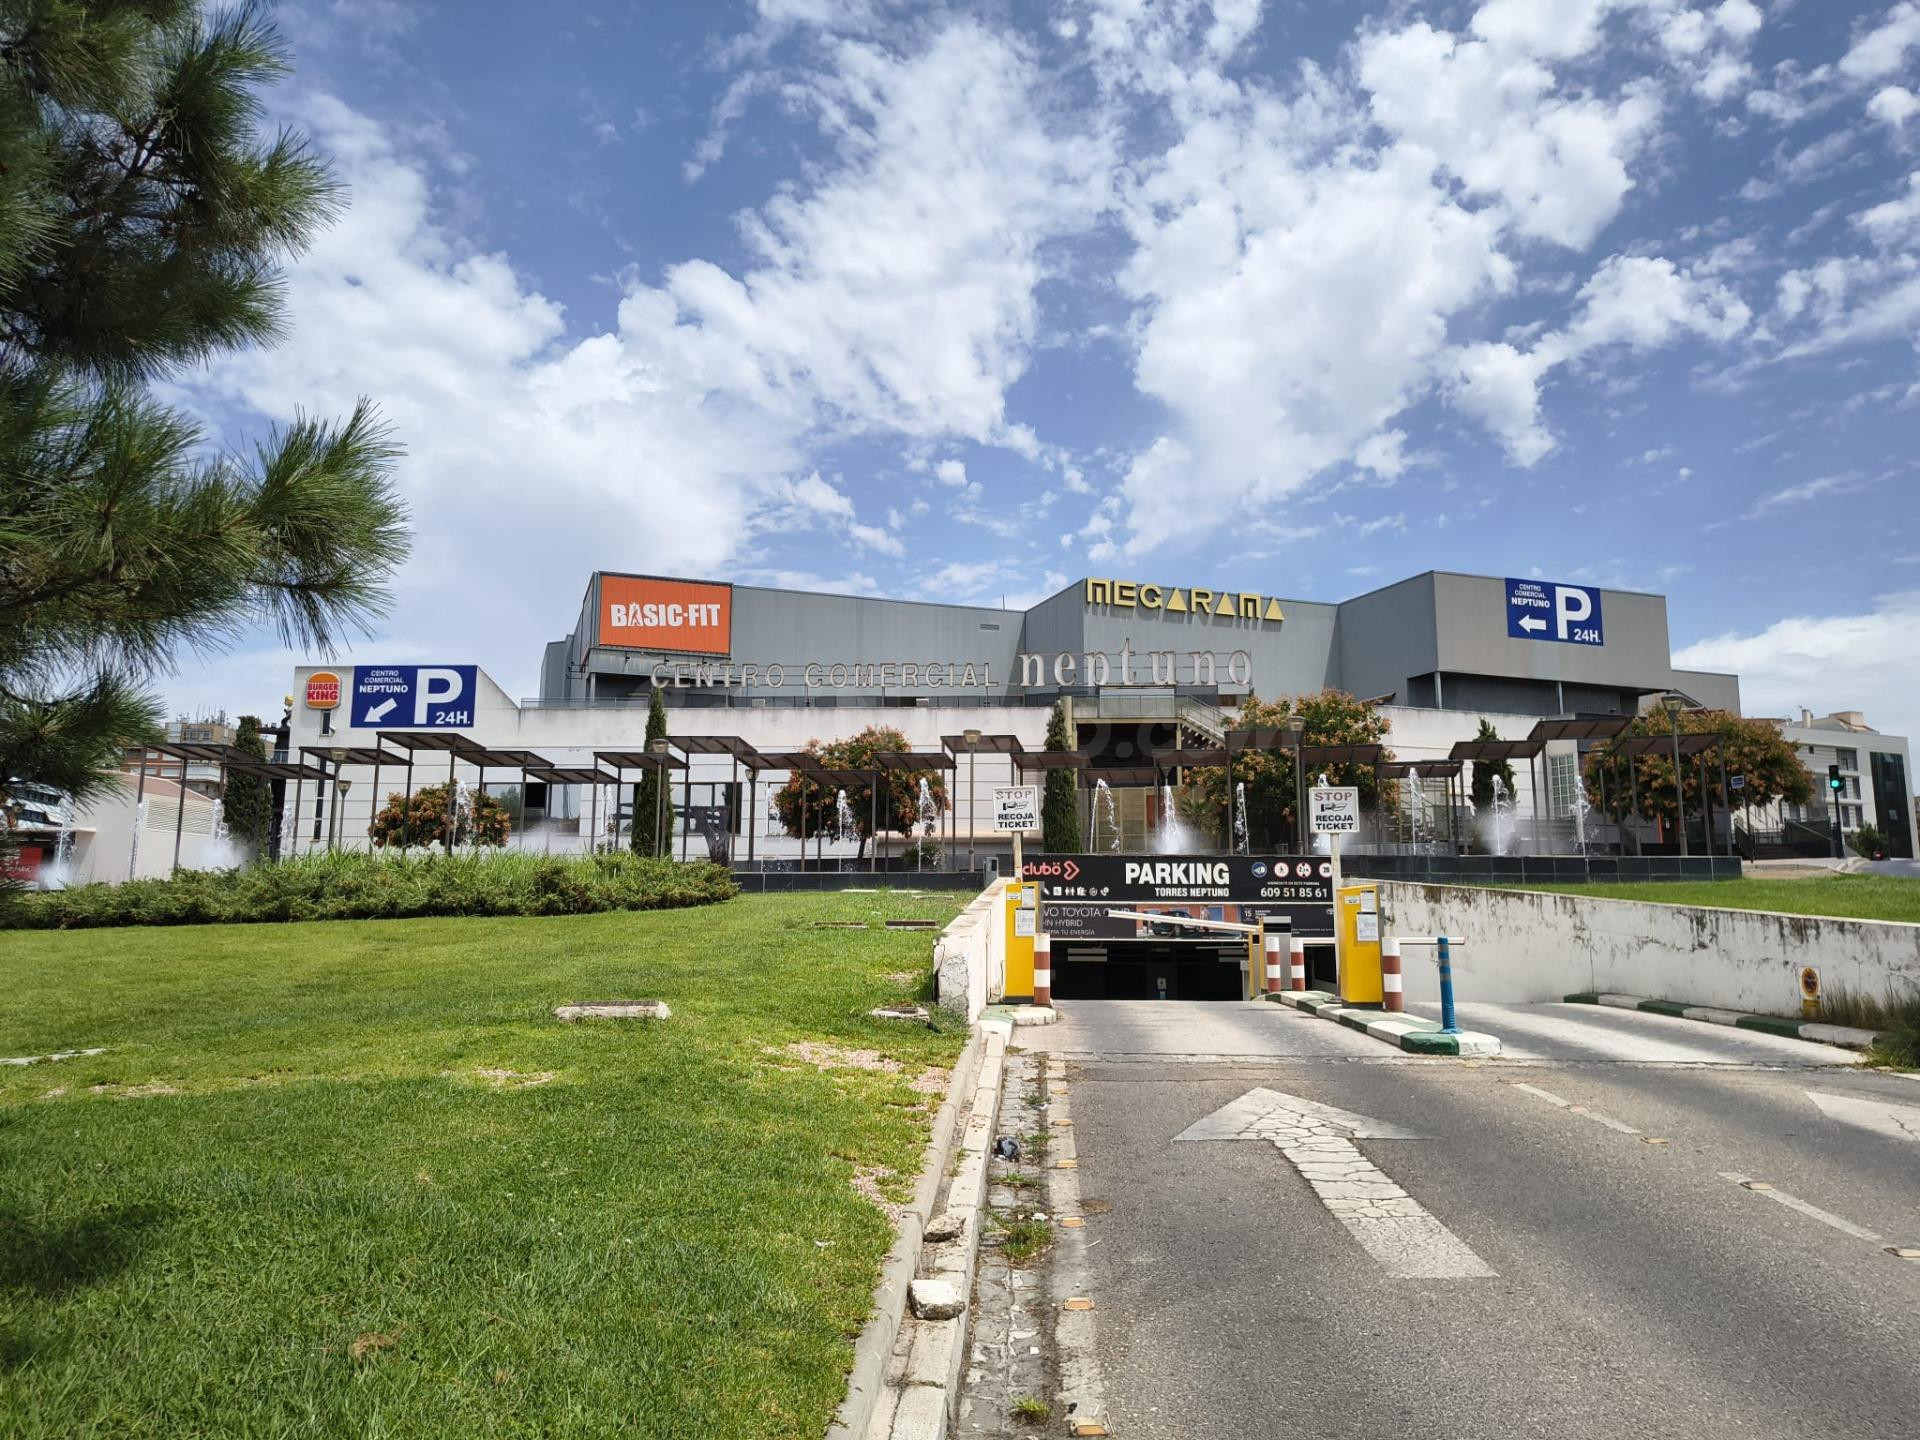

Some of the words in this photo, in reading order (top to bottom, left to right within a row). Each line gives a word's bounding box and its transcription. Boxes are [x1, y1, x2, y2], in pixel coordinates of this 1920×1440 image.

[1519, 584, 1541, 592] CENTRO
[1086, 577, 1286, 622] MEGARAMA
[1514, 590, 1546, 599] COMERCIAL
[1511, 597, 1550, 608] NEPTUNO
[609, 601, 721, 628] BASIC-FIT
[1555, 586, 1592, 640] P
[649, 662, 785, 689] CENTRO
[804, 662, 1000, 689] COMERCIAL
[1018, 637, 1253, 687] neptuno
[307, 682, 340, 690] BURGER
[359, 685, 409, 694] NEPTUNO
[306, 690, 338, 701] KING
[414, 668, 463, 724] P
[996, 790, 1032, 800] STOP
[1314, 792, 1352, 802] STOP
[998, 812, 1034, 820] RECOJA
[998, 820, 1034, 828] TICKET
[1125, 862, 1230, 885] PARKING
[1154, 887, 1188, 897] TORRES
[1190, 887, 1230, 897] NEPTUNO
[1260, 888, 1280, 898] 609
[1283, 888, 1296, 898] 51
[1298, 888, 1312, 898] 85
[1314, 888, 1328, 898] 61
[1062, 907, 1102, 918] TOYOTA
[1055, 919, 1084, 927] HYBRID
